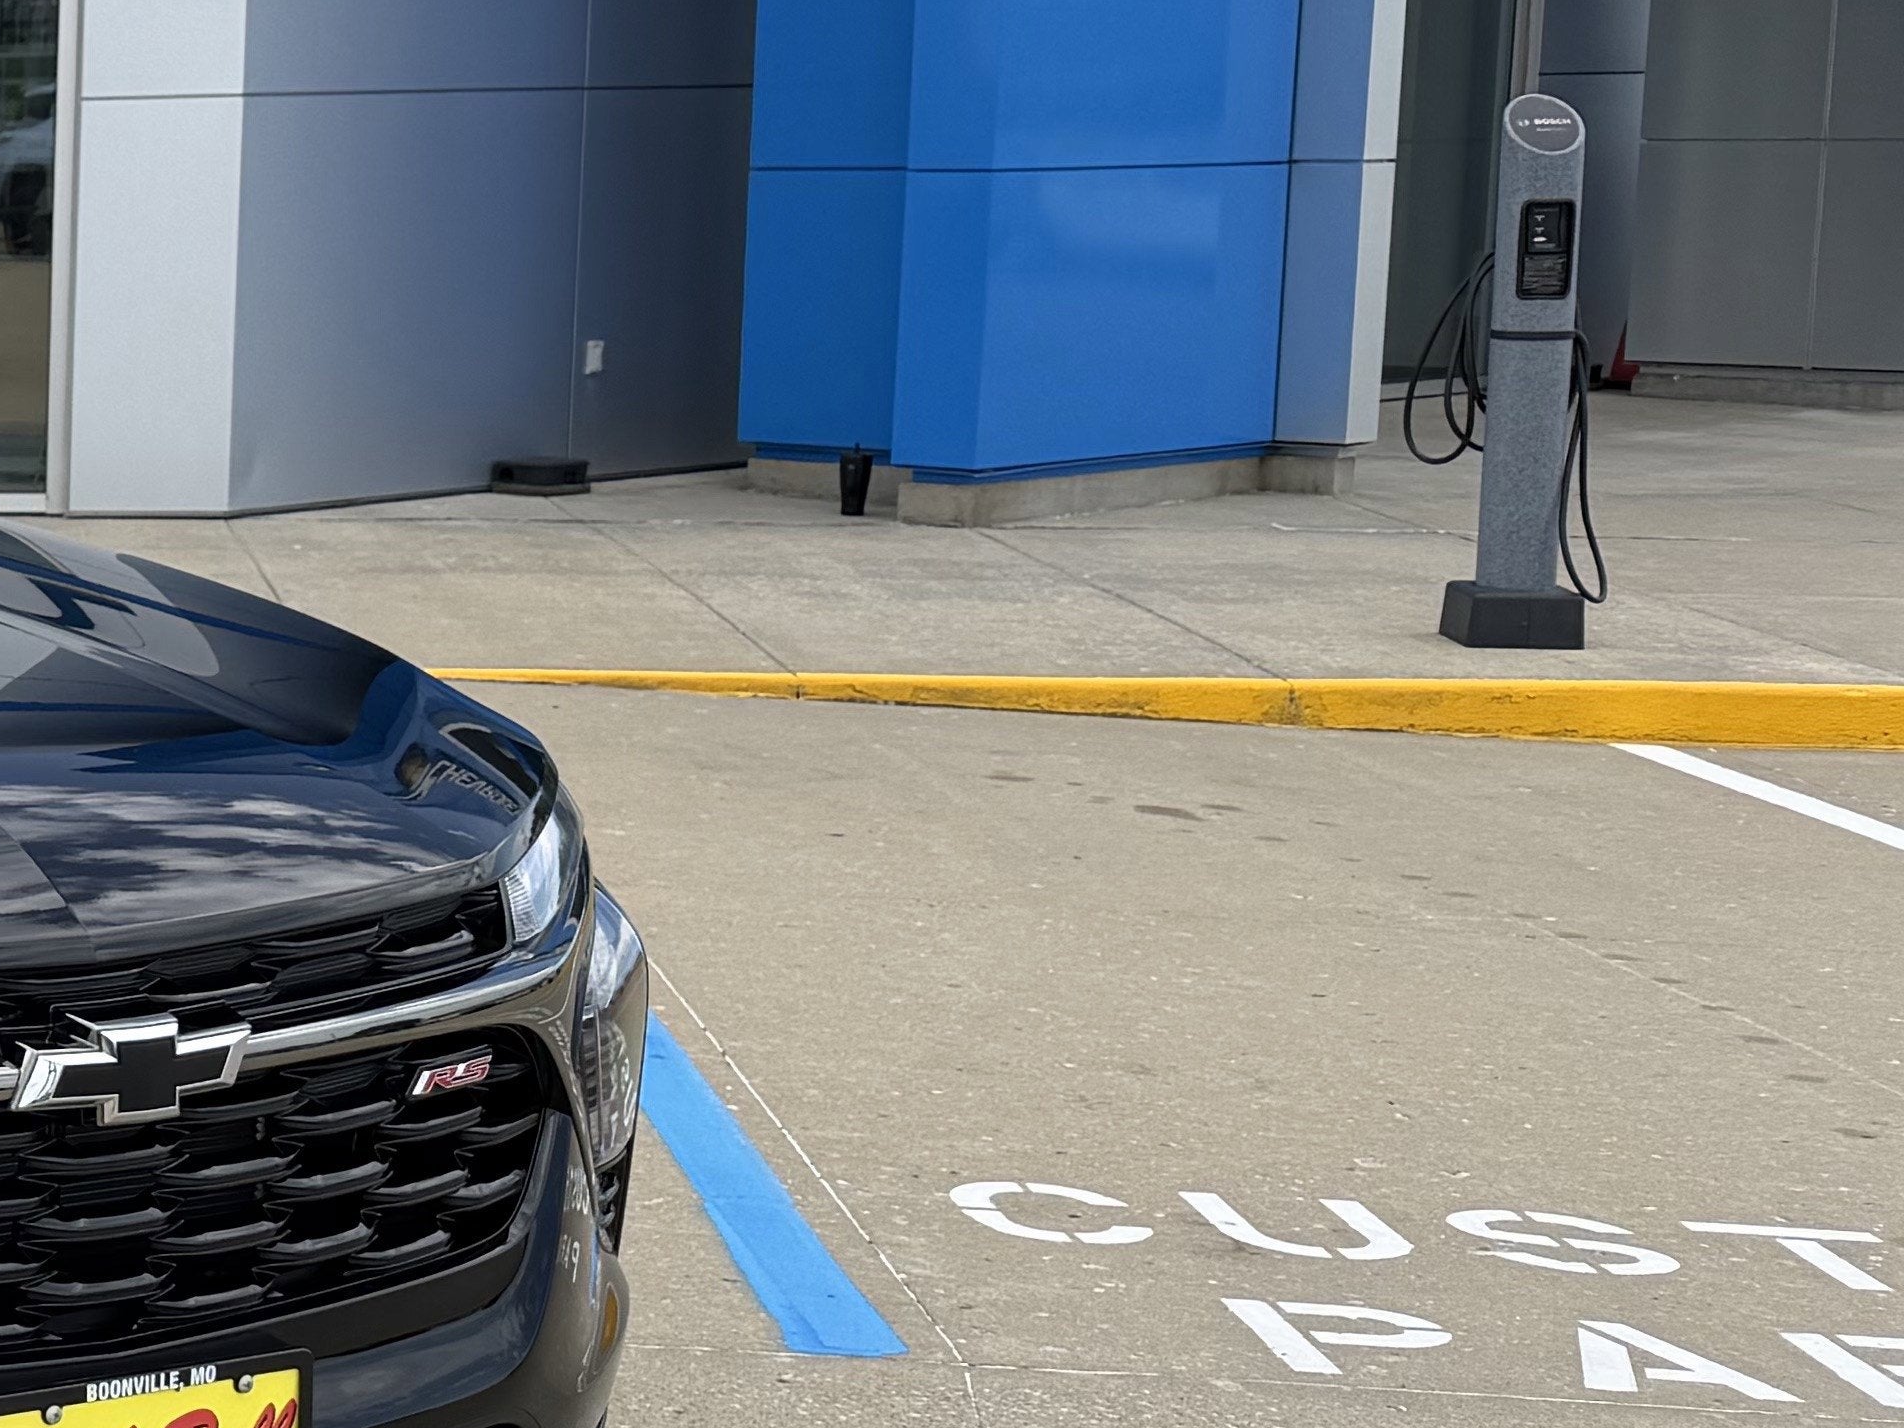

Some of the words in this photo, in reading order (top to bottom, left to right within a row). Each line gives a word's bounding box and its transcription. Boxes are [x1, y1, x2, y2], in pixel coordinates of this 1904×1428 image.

[412, 1055, 492, 1095] RS
[948, 1181, 1895, 1291] CUST
[87, 1370, 184, 1402] BOONVILLE,
[191, 1365, 216, 1385] MO
